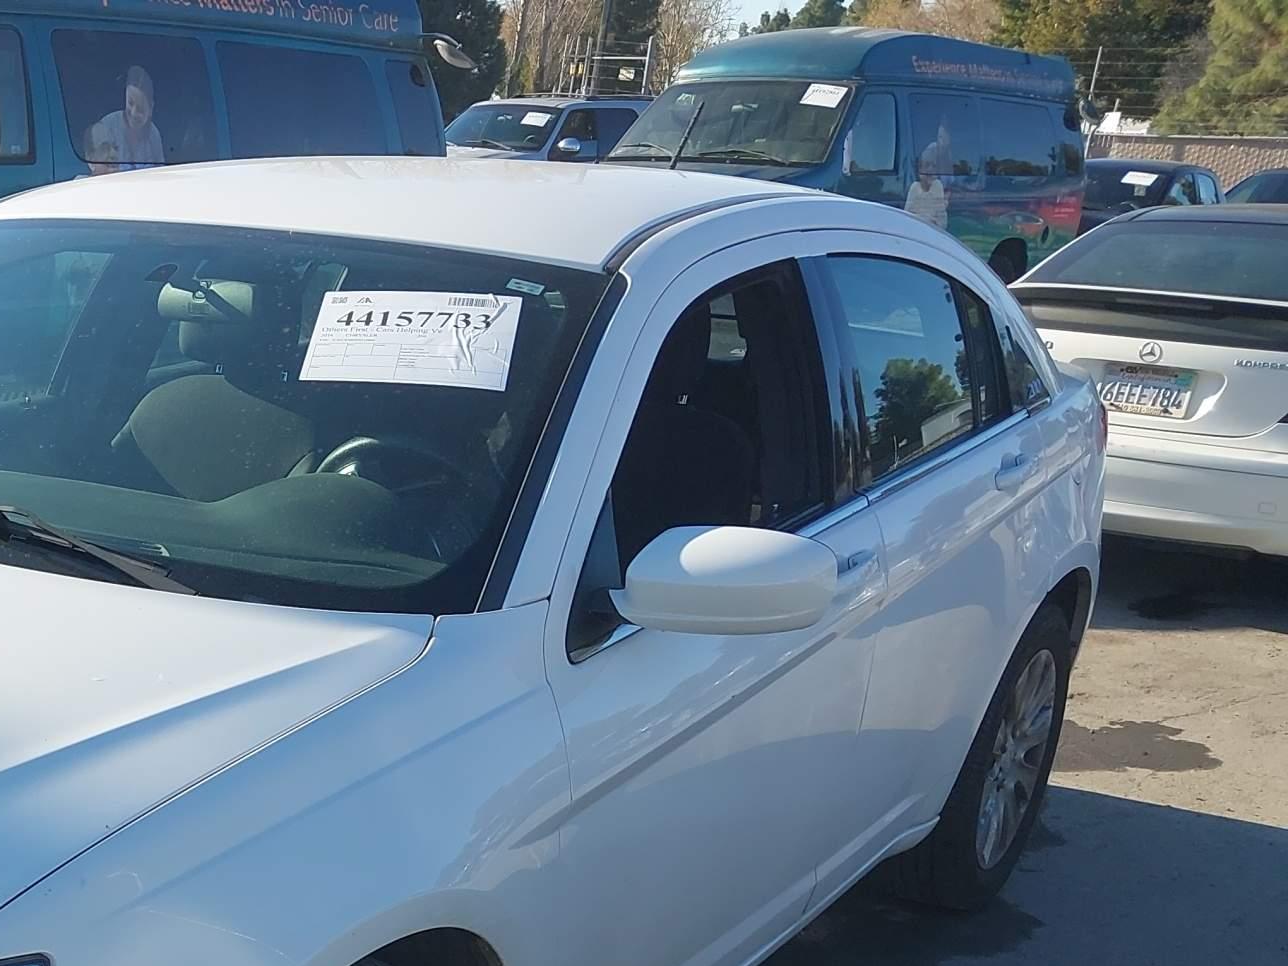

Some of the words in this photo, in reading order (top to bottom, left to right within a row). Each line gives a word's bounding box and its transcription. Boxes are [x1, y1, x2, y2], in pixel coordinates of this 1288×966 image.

[274, 0, 295, 19] in
[297, 0, 353, 26] Senior
[358, 3, 399, 32] Care
[336, 310, 492, 330] 44157733
[1101, 381, 1184, 410] 6EEE784
